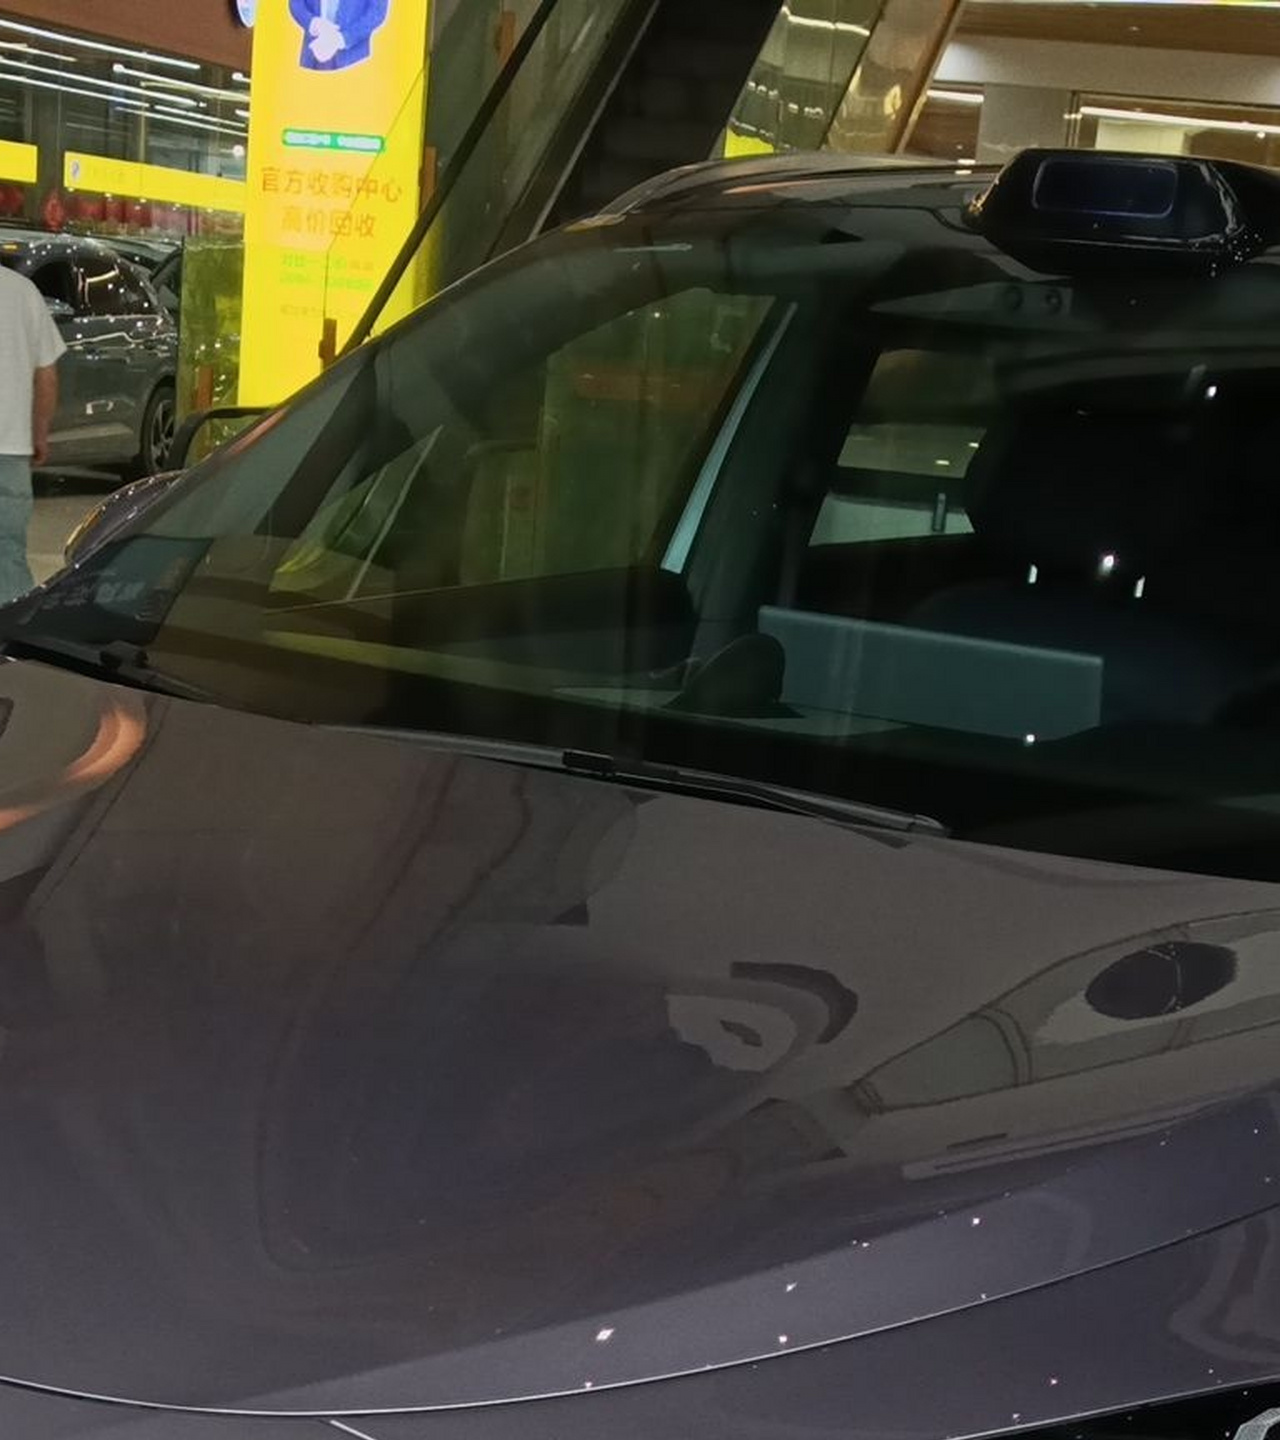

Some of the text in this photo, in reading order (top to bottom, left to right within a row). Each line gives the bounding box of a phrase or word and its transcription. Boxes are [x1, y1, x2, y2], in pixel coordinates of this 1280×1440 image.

[261, 166, 402, 203] 官方收购中心
[282, 205, 376, 238] 高价回收
